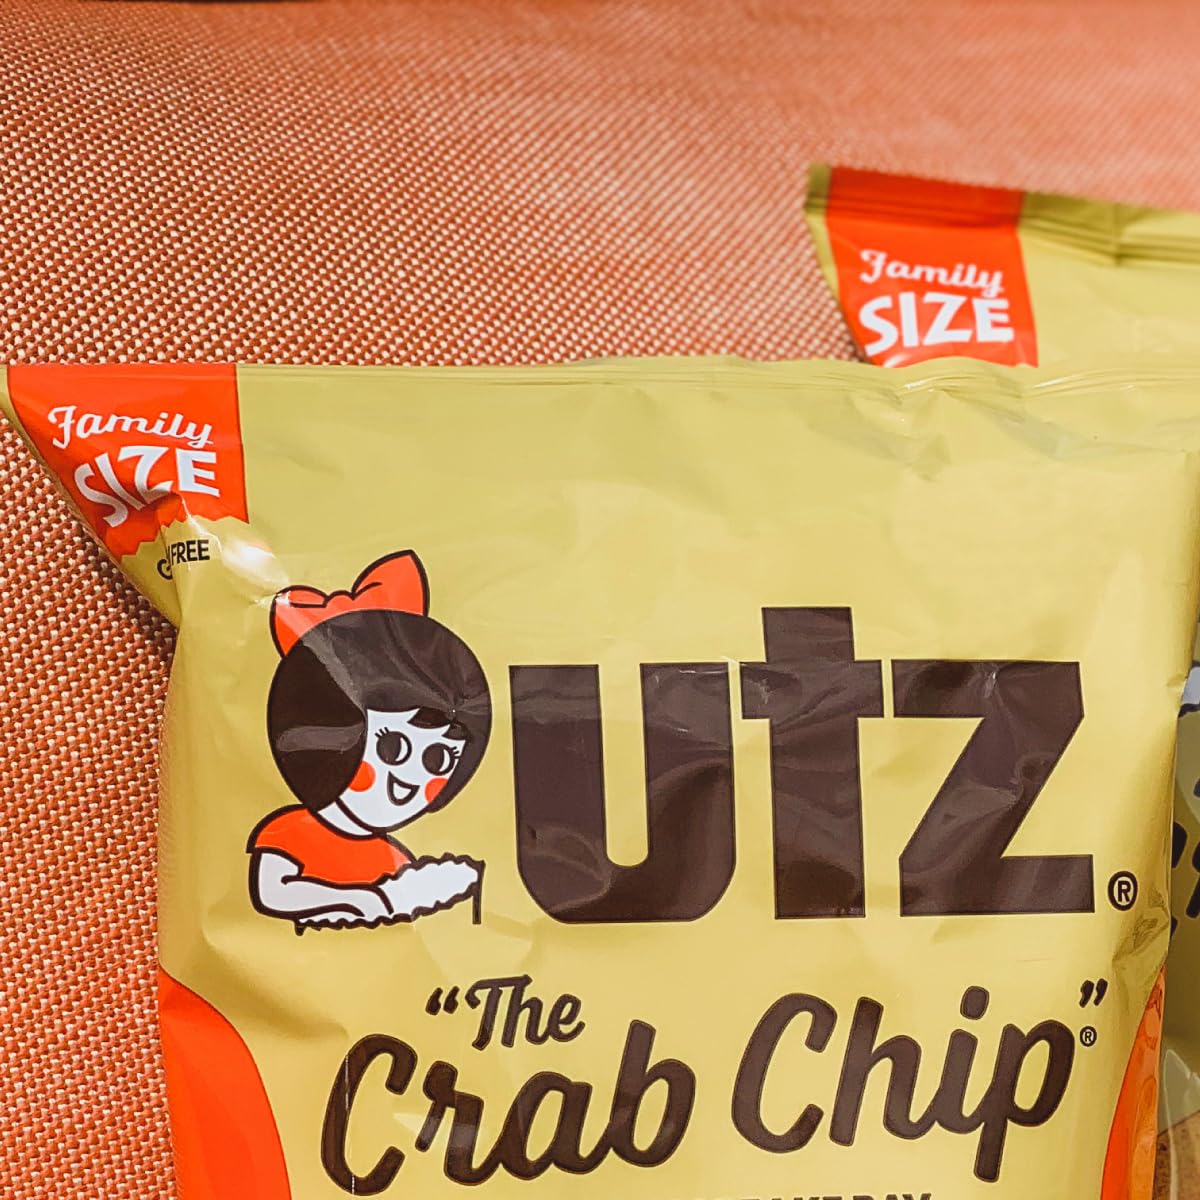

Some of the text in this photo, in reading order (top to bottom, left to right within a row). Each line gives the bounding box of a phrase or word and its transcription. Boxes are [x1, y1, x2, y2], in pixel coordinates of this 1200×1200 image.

[860, 249, 1004, 298] Family
[859, 291, 1014, 356] SIZE
[48, 405, 214, 449] Family
[75, 445, 220, 528] SIZE
[170, 539, 210, 565] FREE
[320, 1018, 697, 1196] Crab
